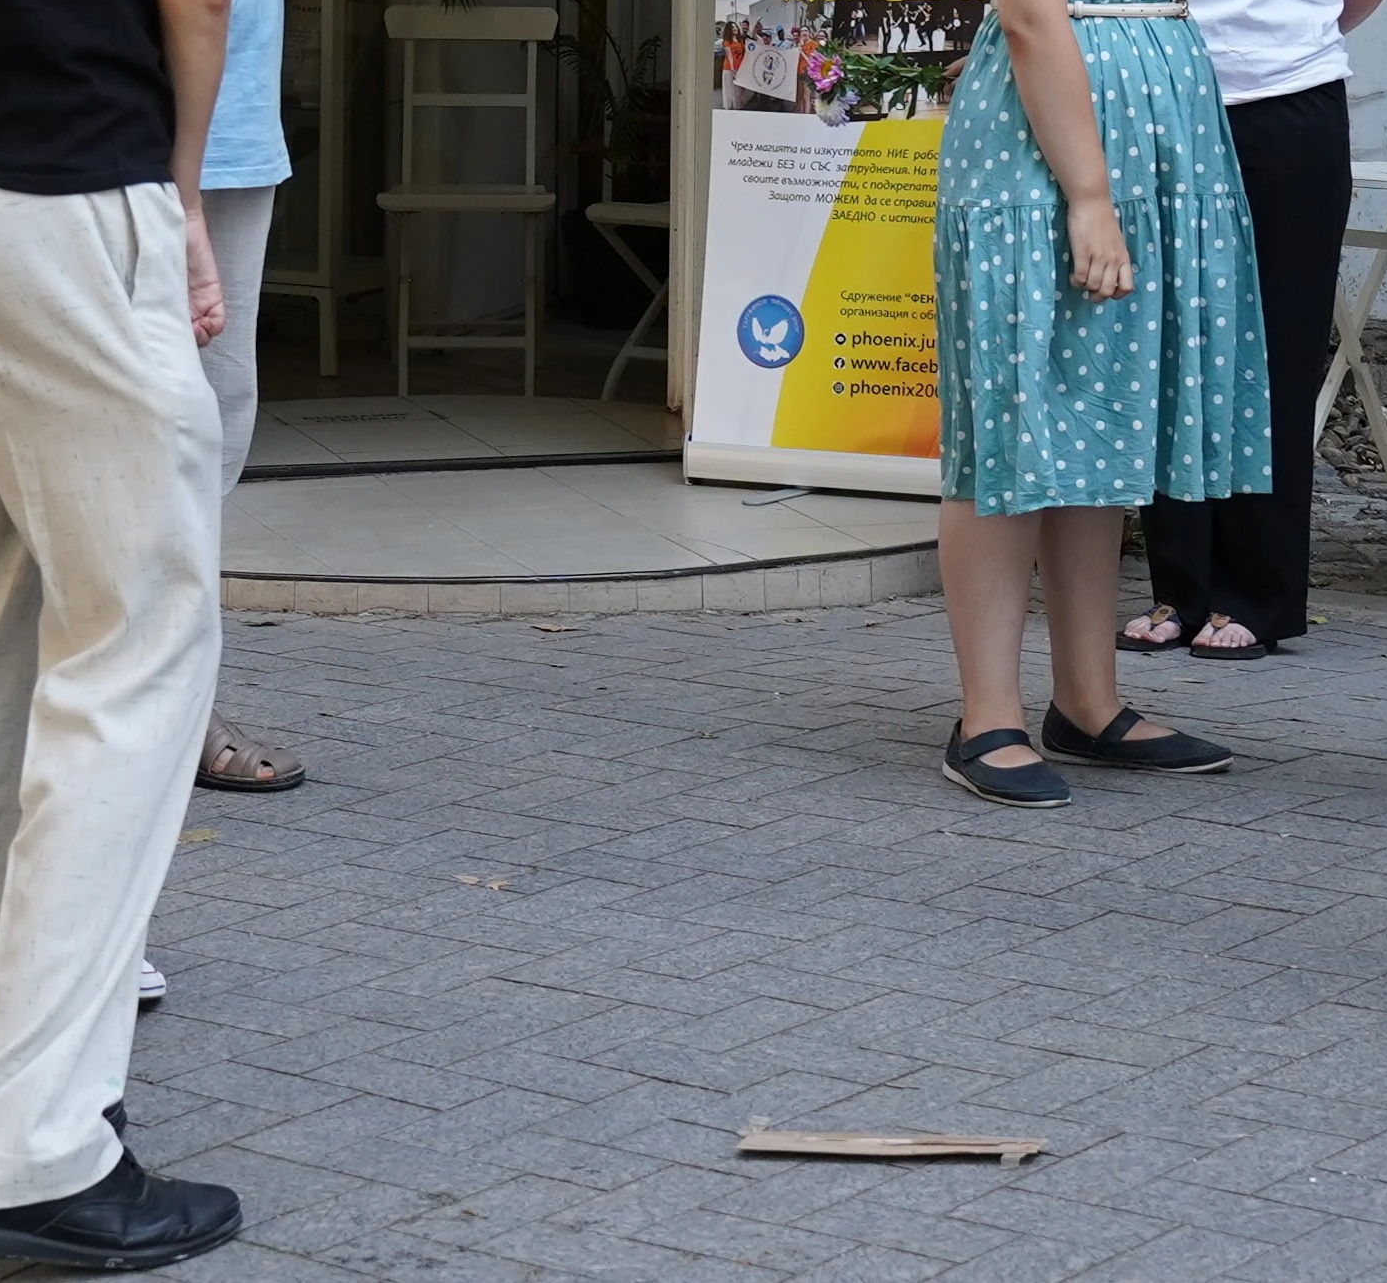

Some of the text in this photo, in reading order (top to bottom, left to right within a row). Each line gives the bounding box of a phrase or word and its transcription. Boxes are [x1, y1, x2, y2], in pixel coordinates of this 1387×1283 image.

[731, 140, 753, 153] Чрез
[755, 143, 798, 154] магията
[800, 146, 812, 155] на
[814, 146, 882, 158] изкуството
[887, 148, 909, 159] НИЕ
[727, 156, 773, 168] младежи
[777, 159, 795, 169] БЕЗ
[799, 162, 806, 170] и
[810, 160, 832, 172] СЪС
[913, 165, 927, 176] На
[743, 174, 938, 193] своите възможности, с подкрепата
[768, 190, 811, 203] Защото
[815, 193, 859, 205] МОЖЕМ
[864, 194, 877, 206] да
[879, 197, 891, 206] се
[832, 209, 876, 223] ЗАЕДНО
[880, 214, 886, 222] с
[840, 289, 902, 303] Сдружение
[840, 307, 908, 320] организация
[911, 311, 917, 320] с
[852, 330, 936, 353] phoenix.ju
[850, 357, 939, 374] www.faceb
